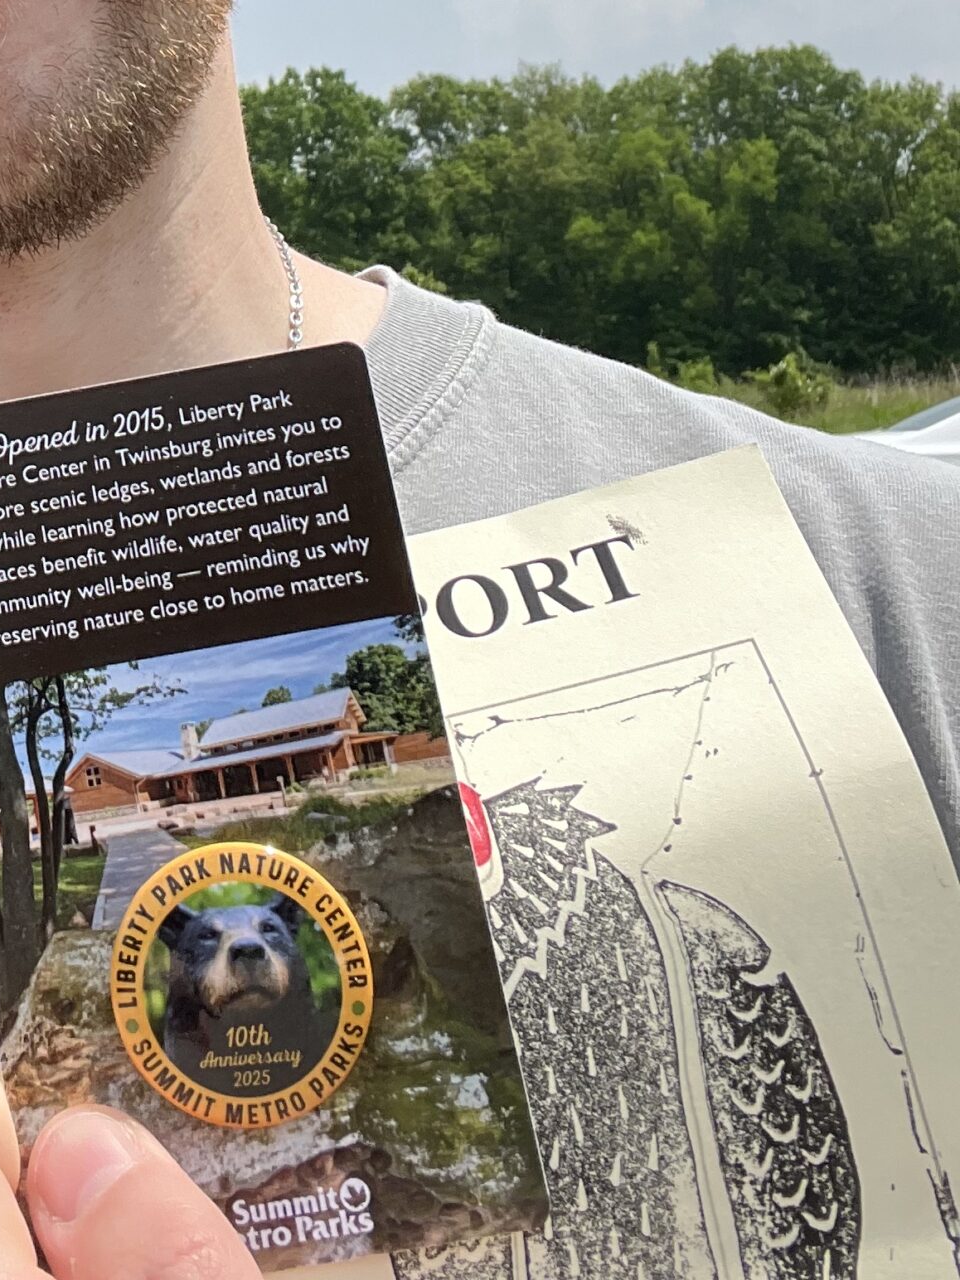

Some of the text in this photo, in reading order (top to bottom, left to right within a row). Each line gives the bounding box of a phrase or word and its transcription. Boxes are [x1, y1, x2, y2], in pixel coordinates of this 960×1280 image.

[85, 422, 110, 443] in
[112, 405, 173, 438] 2015,
[178, 401, 245, 426] Liberty
[249, 389, 293, 413] Park
[22, 460, 88, 484] Center
[93, 454, 111, 472] in
[114, 438, 214, 467] Twinsburg
[216, 427, 277, 450] invites
[280, 420, 316, 444] you
[320, 416, 342, 431] to
[30, 489, 88, 514] scenic
[91, 480, 155, 503] ledges,
[159, 460, 243, 491] wetlands
[247, 452, 282, 475] and
[285, 445, 351, 469] forests
[40, 518, 116, 544] learning
[118, 510, 160, 530] how
[165, 487, 258, 527] protected
[263, 475, 329, 504] natural
[40, 547, 108, 575] benefit
[111, 534, 183, 562] wildlife,
[187, 527, 243, 548] water
[248, 513, 310, 543] quality
[315, 503, 350, 527] and
[77, 571, 174, 600] well-being
[206, 548, 301, 578] reminding
[304, 544, 327, 560] us
[330, 534, 370, 557] why
[418, 534, 641, 638] ORT
[83, 608, 145, 631] nature
[150, 599, 199, 620] close
[203, 594, 226, 610] to
[229, 584, 285, 606] home
[290, 570, 369, 595] matters.
[116, 852, 368, 1009] LIBERTY PARK NATURE CENTER
[199, 1049, 303, 1069] Anniversary
[226, 1023, 273, 1048] 10th
[132, 1021, 364, 1125] SUMMIT METRO PARKS
[233, 1069, 272, 1088] 2025
[231, 1186, 340, 1226] Summit
[294, 1209, 375, 1243] Parks
